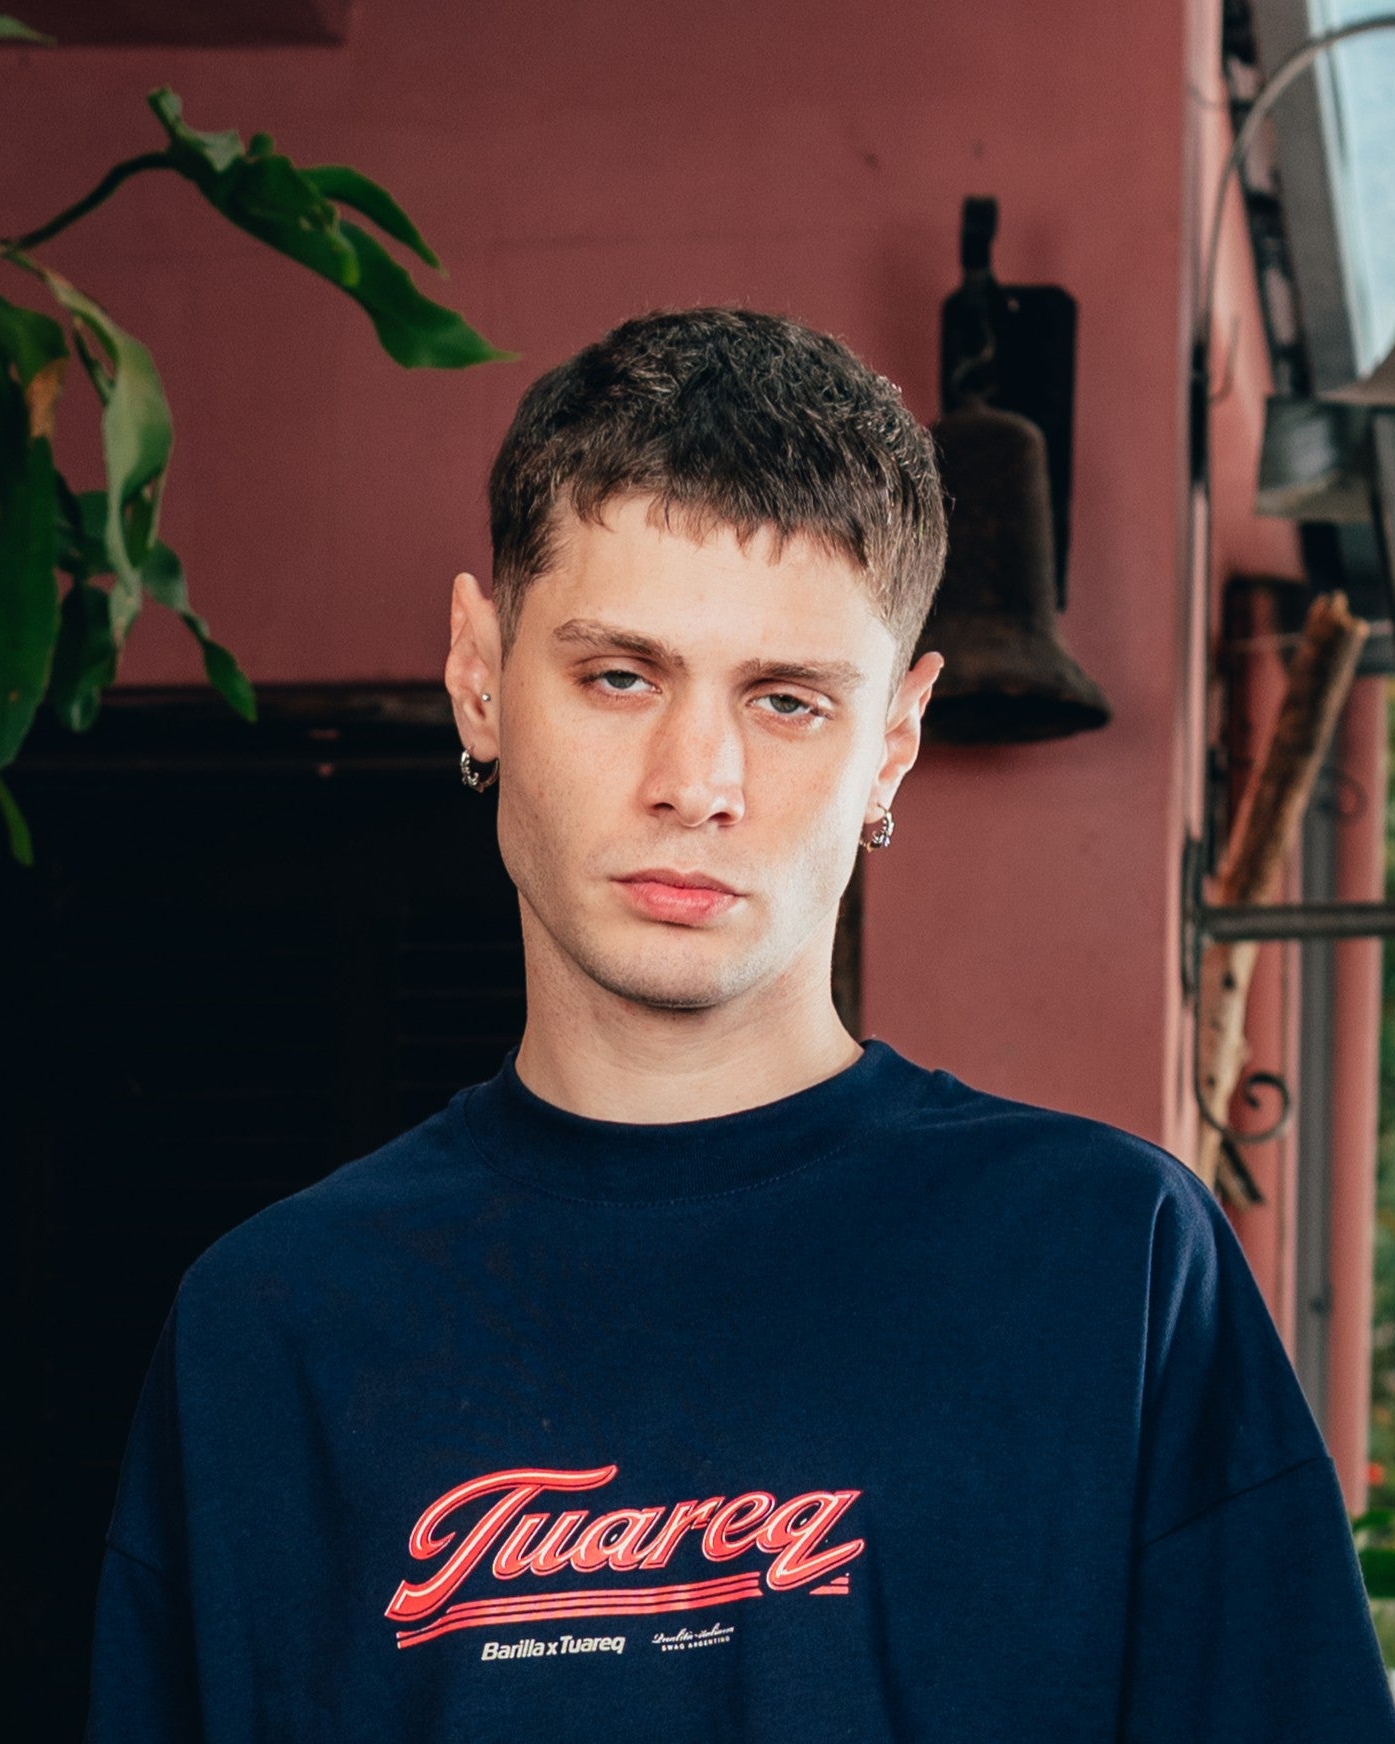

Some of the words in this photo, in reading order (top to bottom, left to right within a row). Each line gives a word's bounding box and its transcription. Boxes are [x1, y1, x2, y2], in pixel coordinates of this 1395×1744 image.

[384, 1465, 865, 1622] Tuareq
[481, 1639, 545, 1661] Barilla
[546, 1641, 559, 1656] x
[560, 1635, 626, 1655] Tuareq
[661, 1643, 685, 1652] SWAG
